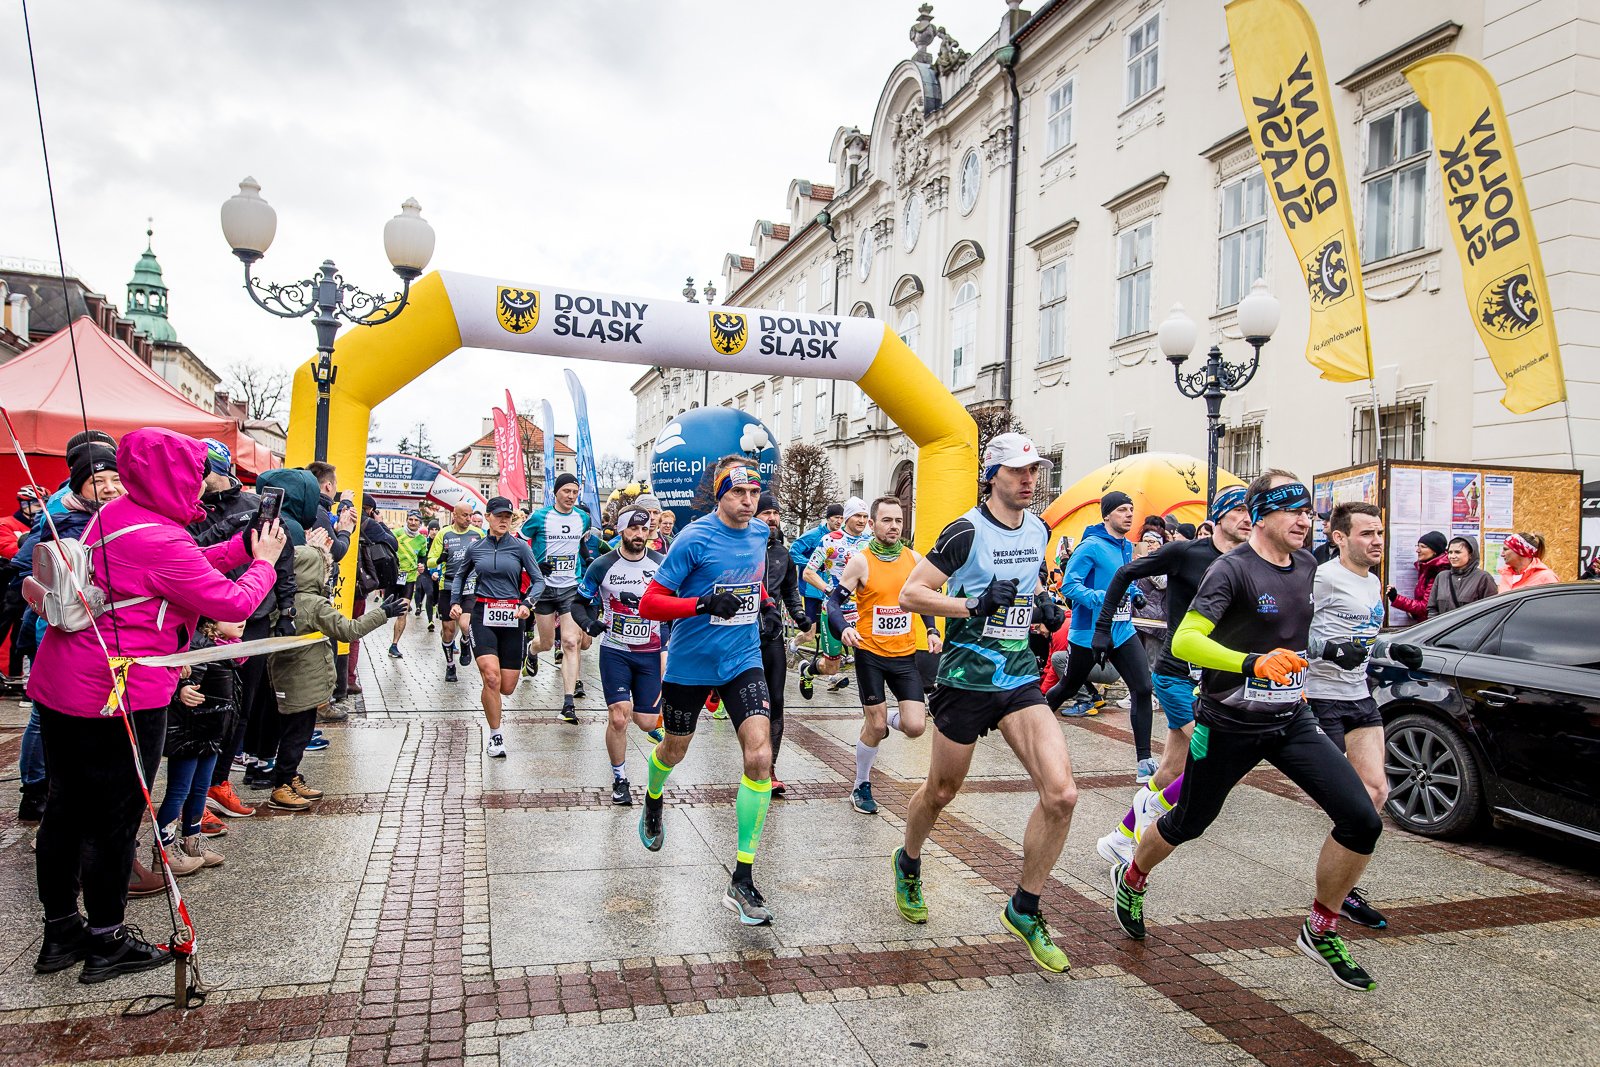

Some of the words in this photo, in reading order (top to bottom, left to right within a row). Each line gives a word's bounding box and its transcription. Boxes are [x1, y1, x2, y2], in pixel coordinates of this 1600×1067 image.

[554, 293, 649, 320] DOLNY
[553, 310, 643, 344] ŚLĄSK
[759, 315, 842, 338] DOLNY
[759, 330, 839, 361] ŚLĄSK
[378, 464, 413, 474] BIEG
[558, 561, 575, 570] 124
[488, 610, 515, 622] 3964
[878, 615, 908, 630] 3823
[1010, 608, 1031, 626] 187
[624, 624, 648, 636] 300
